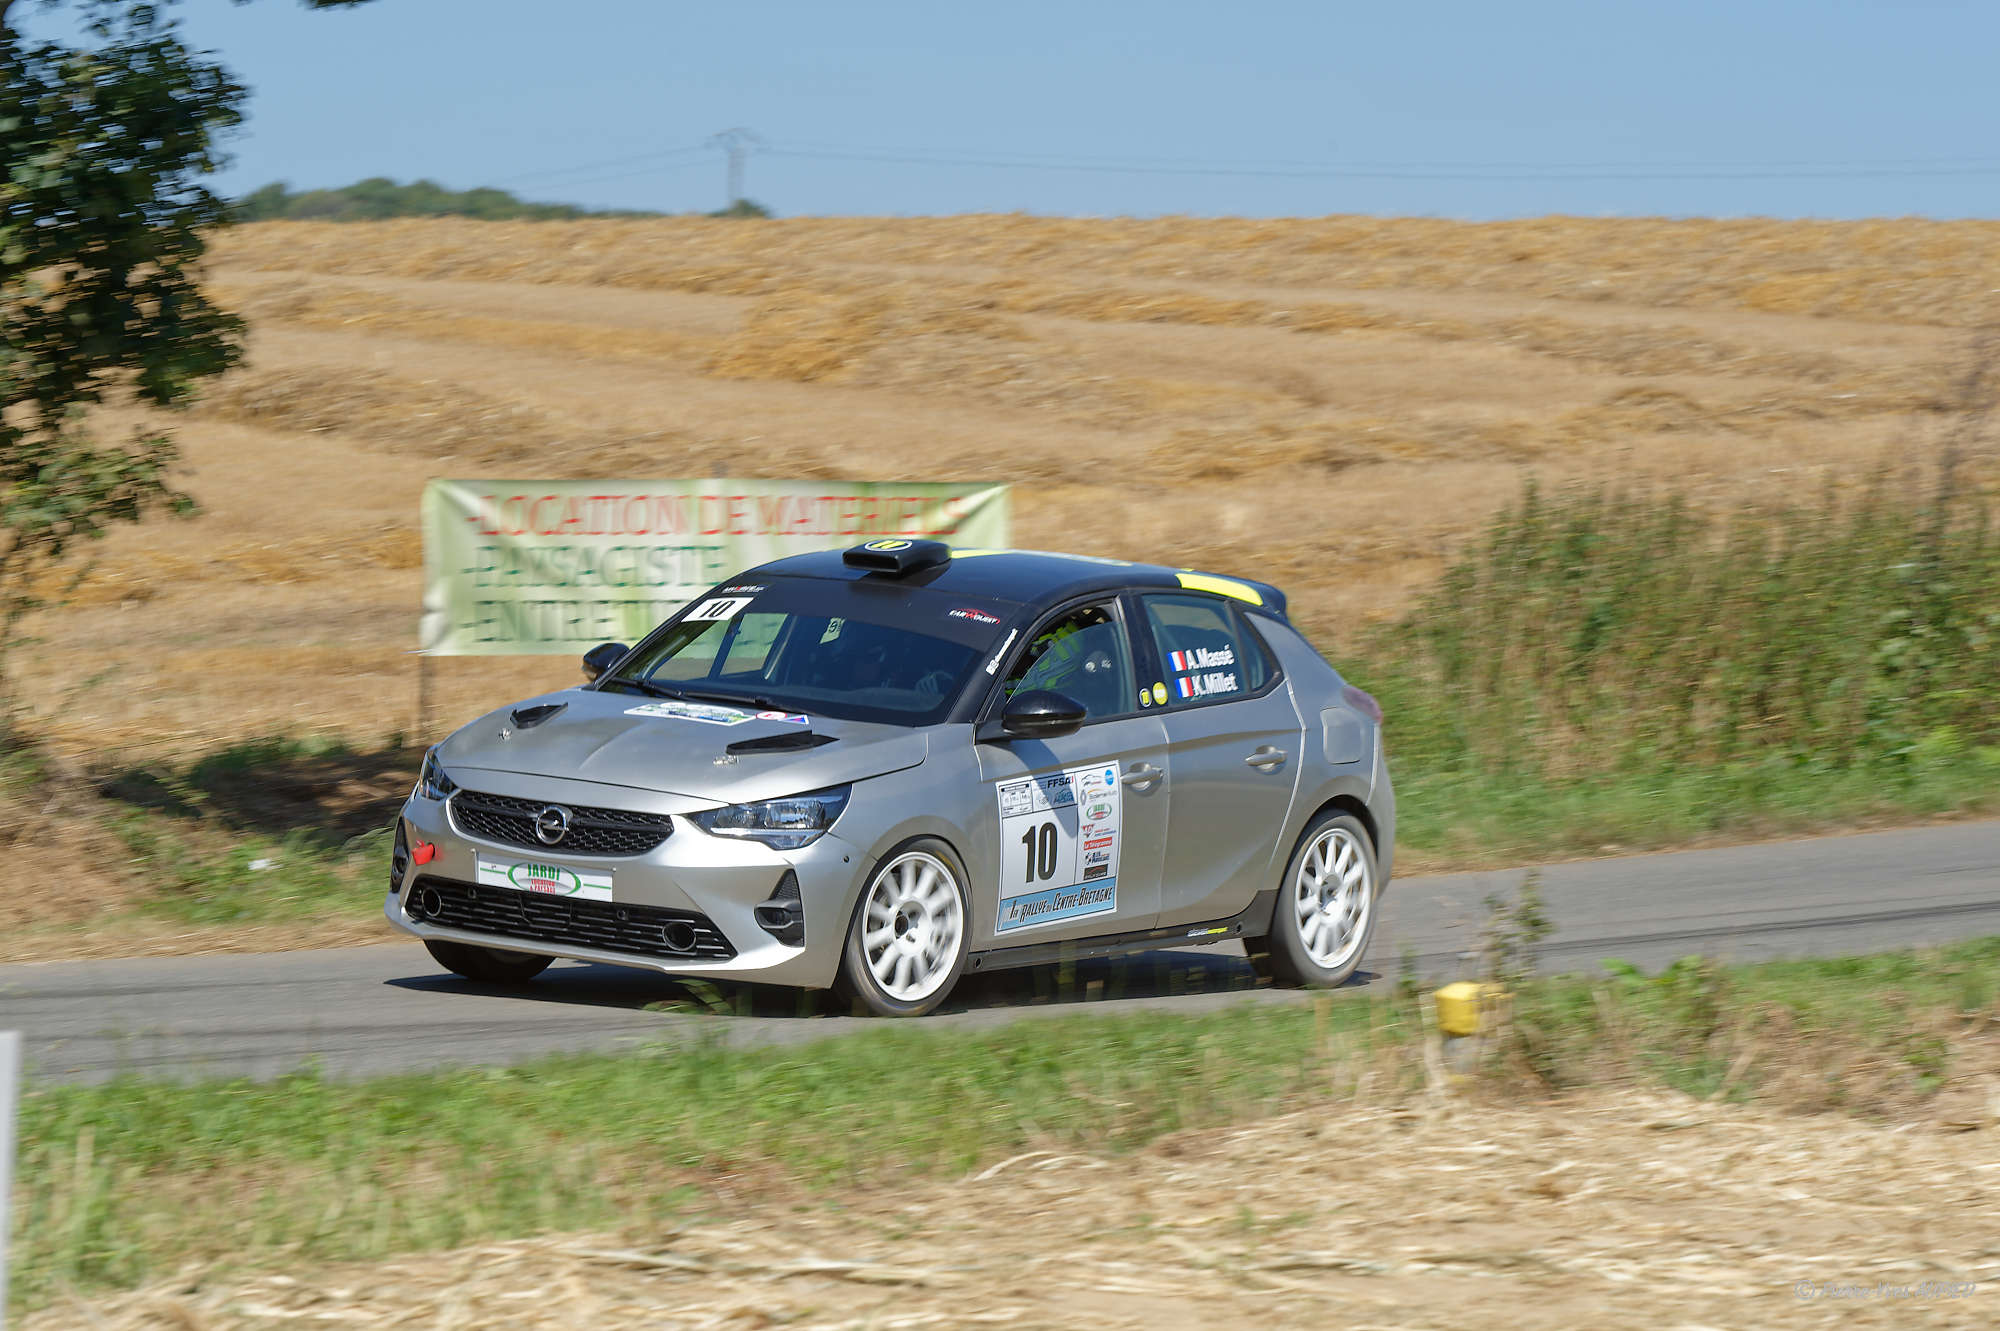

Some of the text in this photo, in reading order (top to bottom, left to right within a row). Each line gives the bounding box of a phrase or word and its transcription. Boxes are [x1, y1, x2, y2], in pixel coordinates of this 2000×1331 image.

[697, 495, 750, 536] DE
[700, 600, 736, 618] 10
[1186, 644, 1235, 670] A.Massé
[1022, 822, 1058, 883] 10
